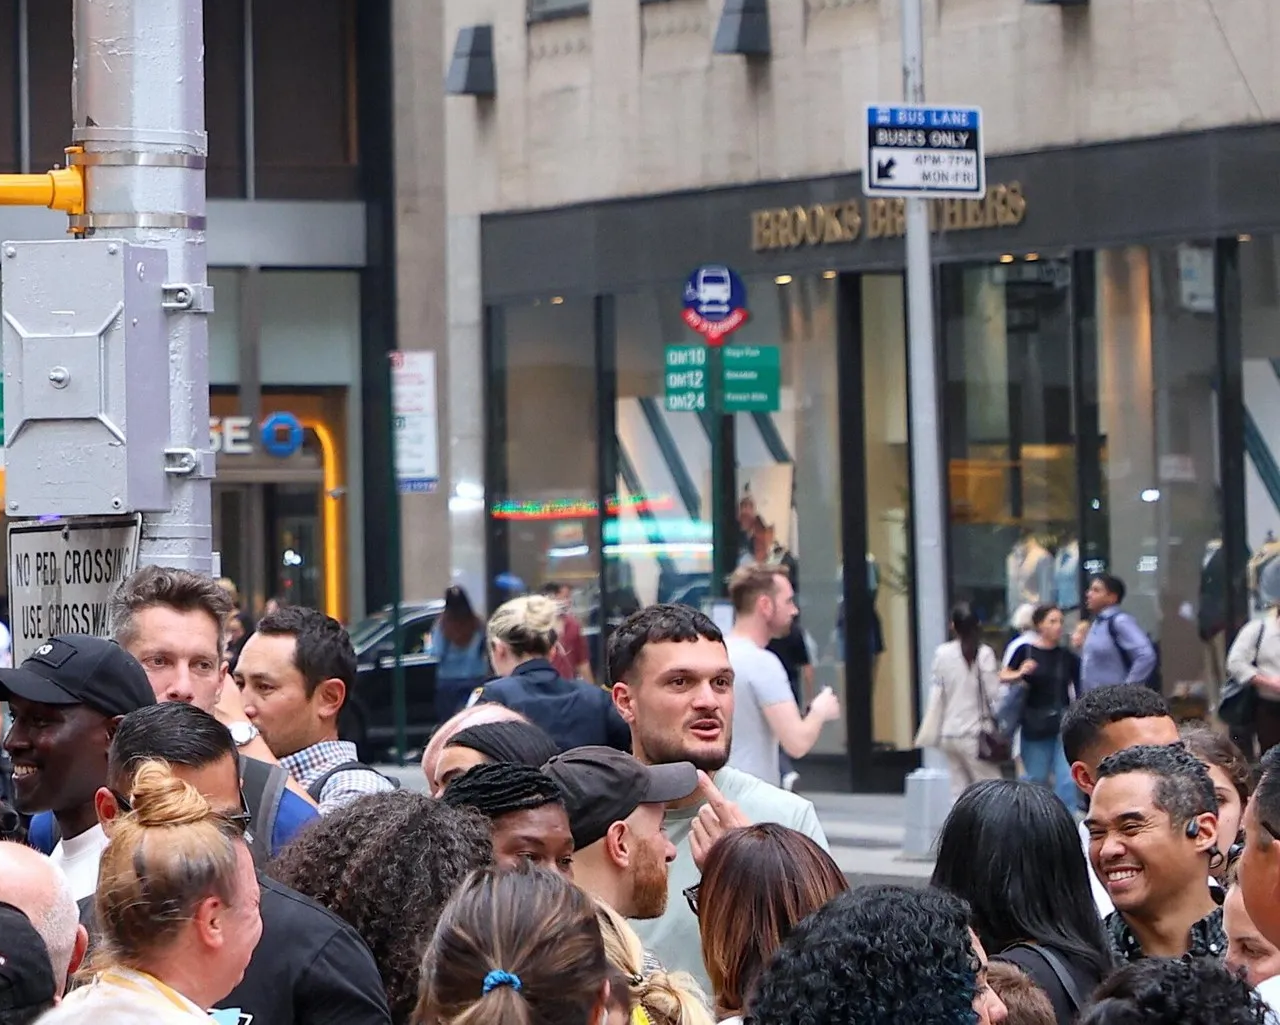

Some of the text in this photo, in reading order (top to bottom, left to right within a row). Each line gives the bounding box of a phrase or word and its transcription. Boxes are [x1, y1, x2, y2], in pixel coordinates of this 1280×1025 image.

[899, 111, 970, 125] BUS LANE
[876, 130, 970, 147] BUSES ONLY
[752, 179, 1026, 251] BROOKS BRTHERS
[16, 552, 31, 587] NO
[64, 547, 130, 586] CROSSING
[22, 604, 43, 640] USE
